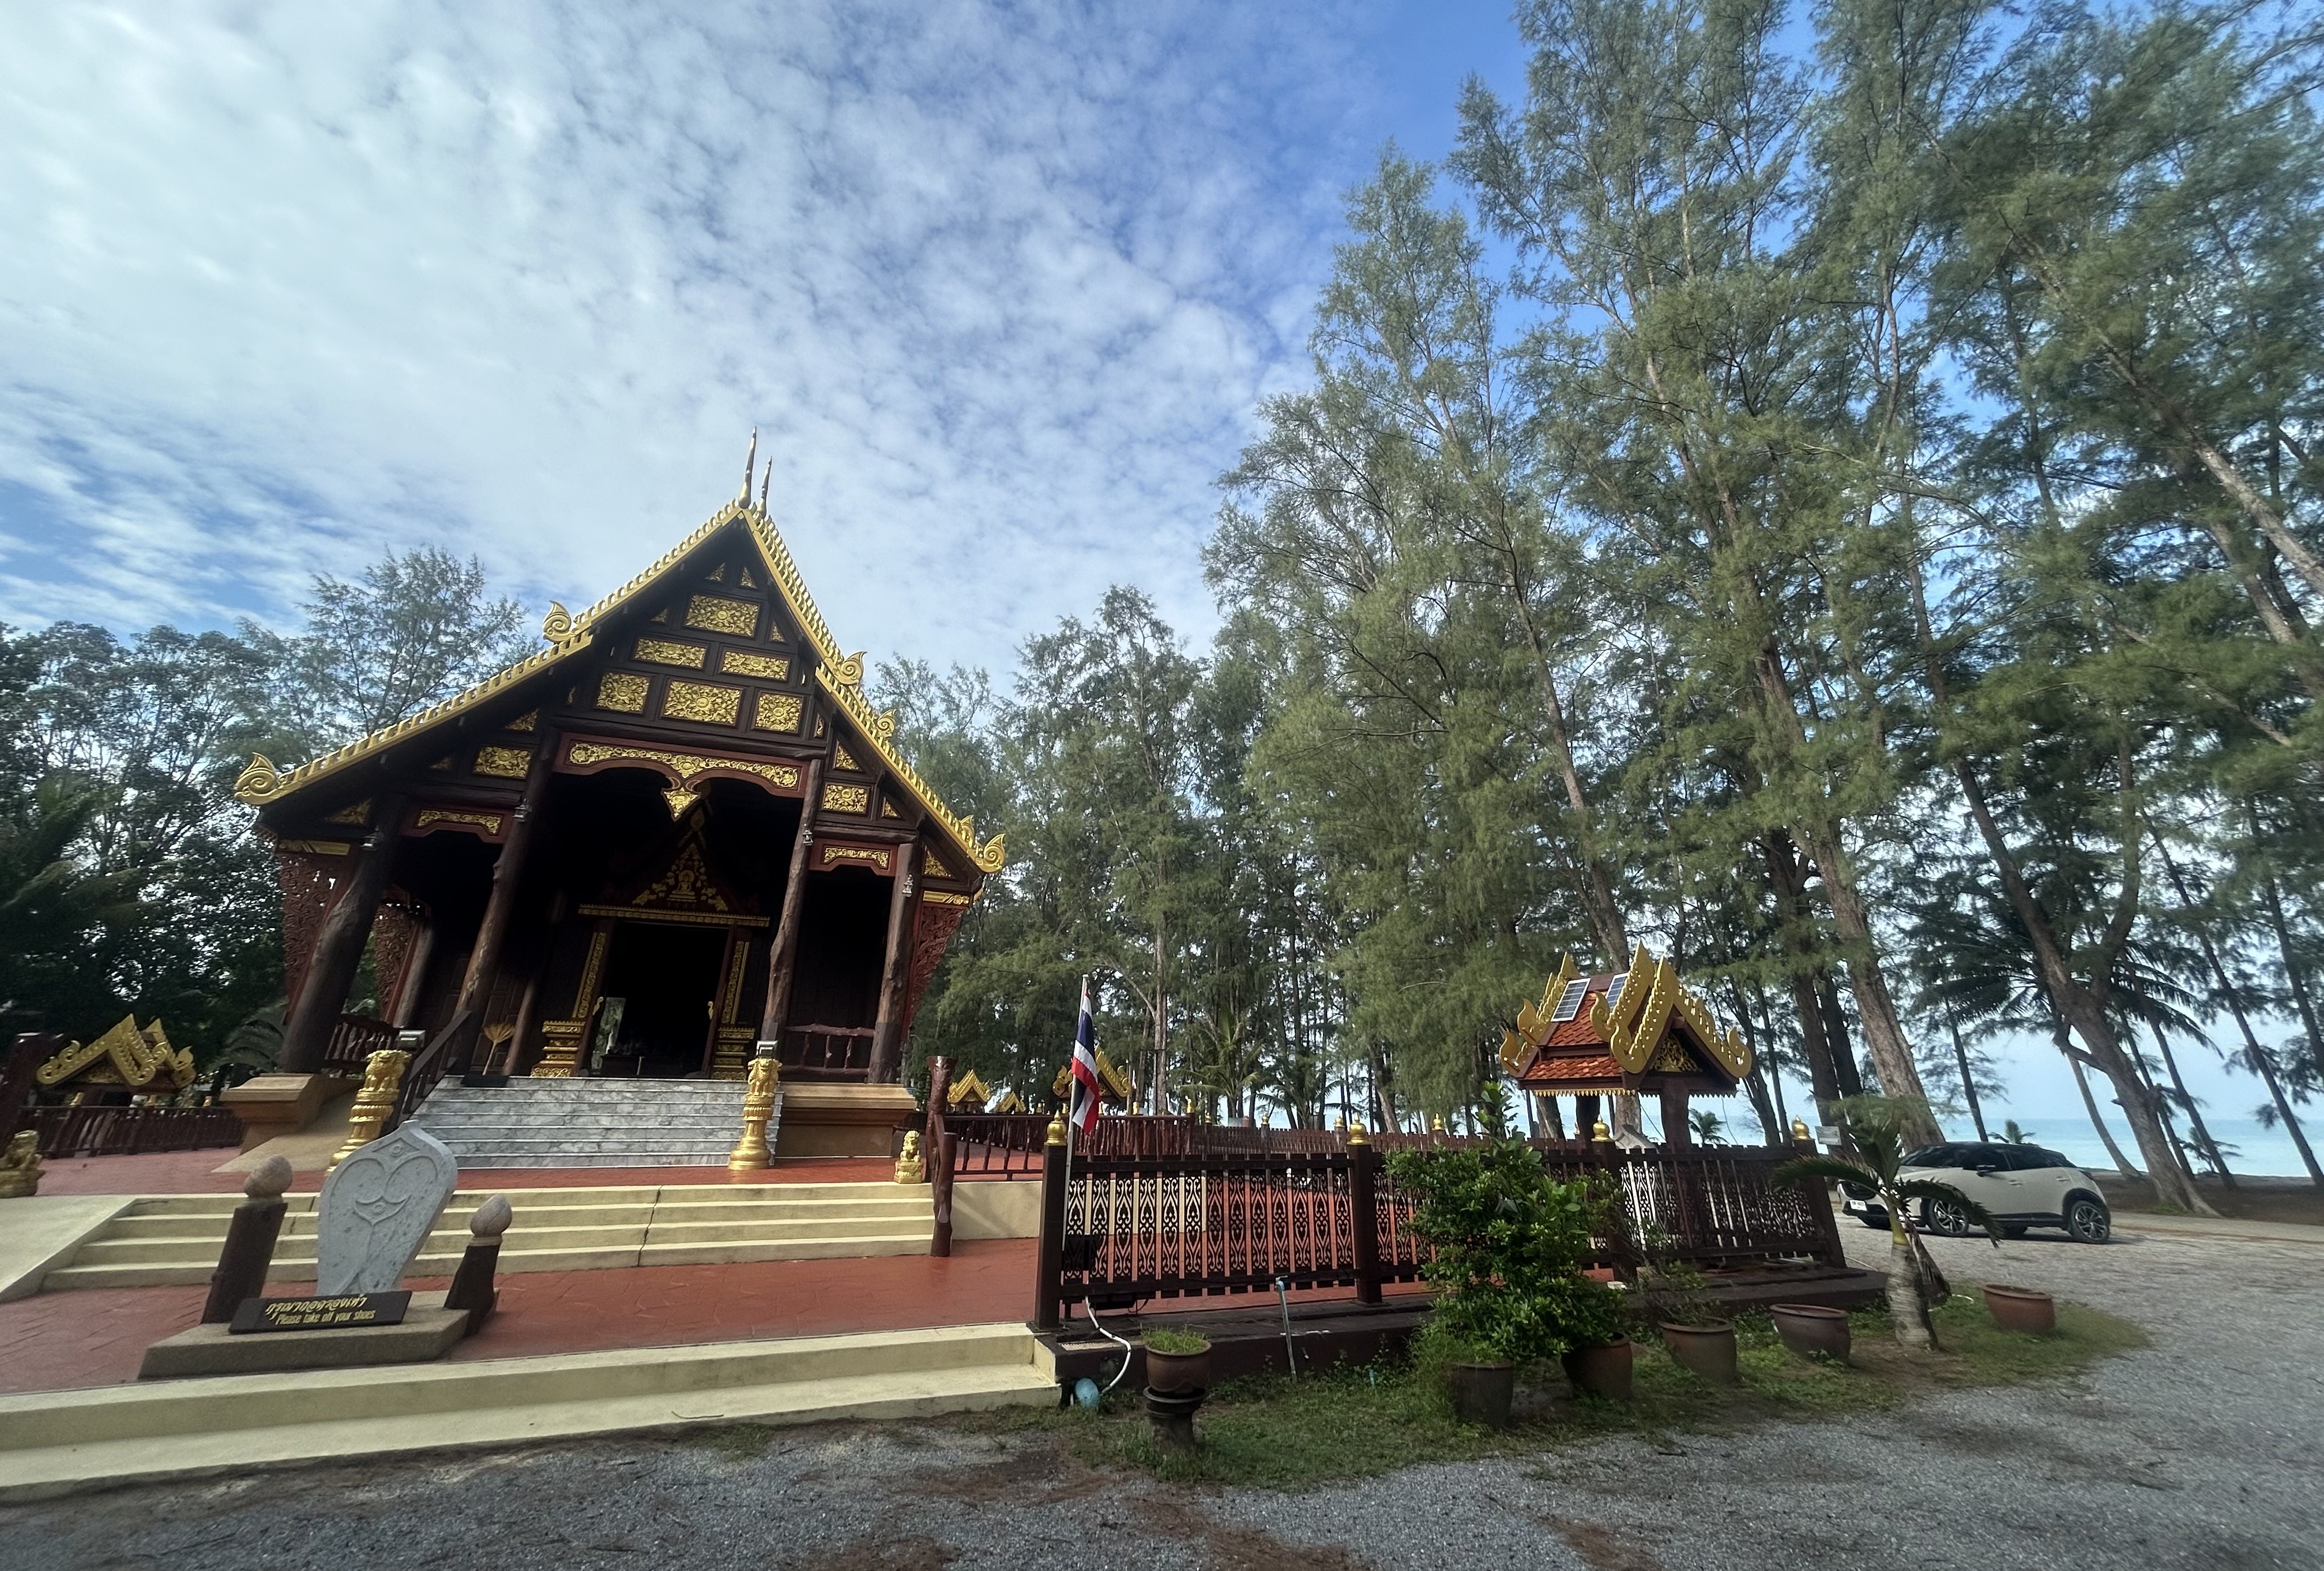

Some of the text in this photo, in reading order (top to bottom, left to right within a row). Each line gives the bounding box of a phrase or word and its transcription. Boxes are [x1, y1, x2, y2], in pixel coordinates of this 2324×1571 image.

[265, 1293, 368, 1320] กรุณาถอดรองเท้า
[275, 1310, 376, 1325] Please take off your shoes
